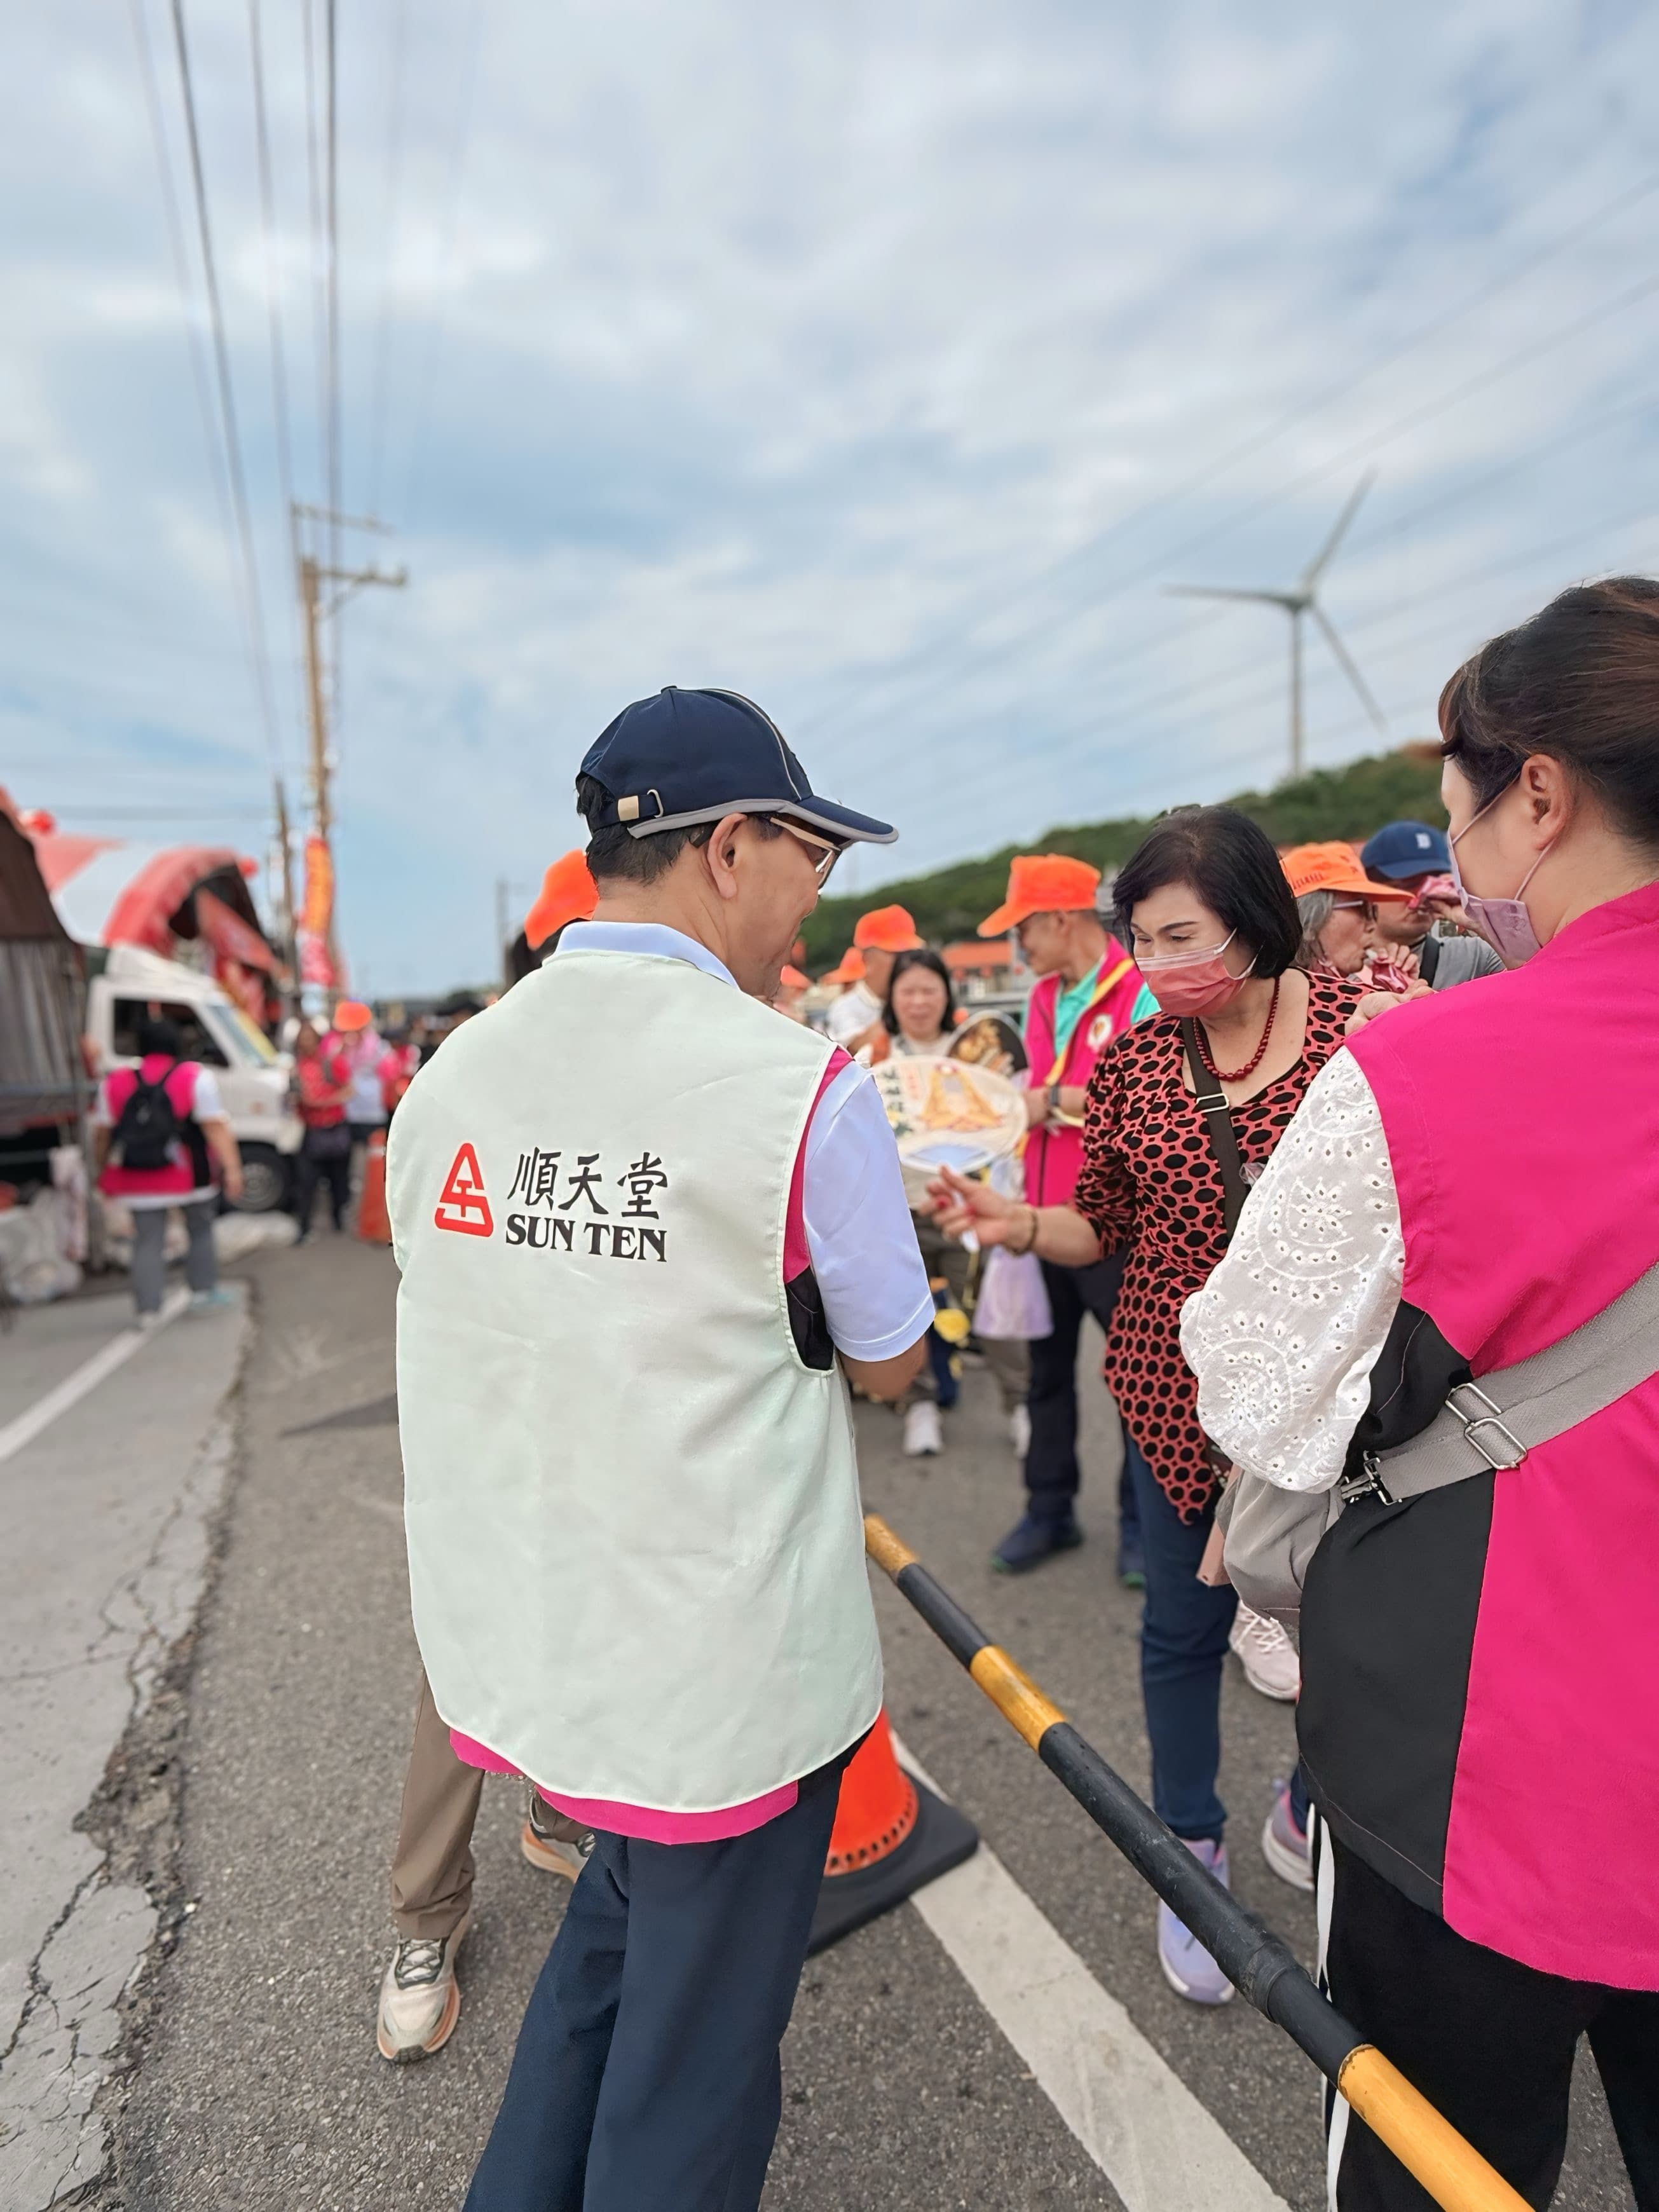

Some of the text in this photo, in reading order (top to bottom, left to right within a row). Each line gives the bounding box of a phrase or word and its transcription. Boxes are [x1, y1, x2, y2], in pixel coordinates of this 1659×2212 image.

[507, 1147, 668, 1219] 順天堂
[506, 1213, 667, 1262] SUN TEN
